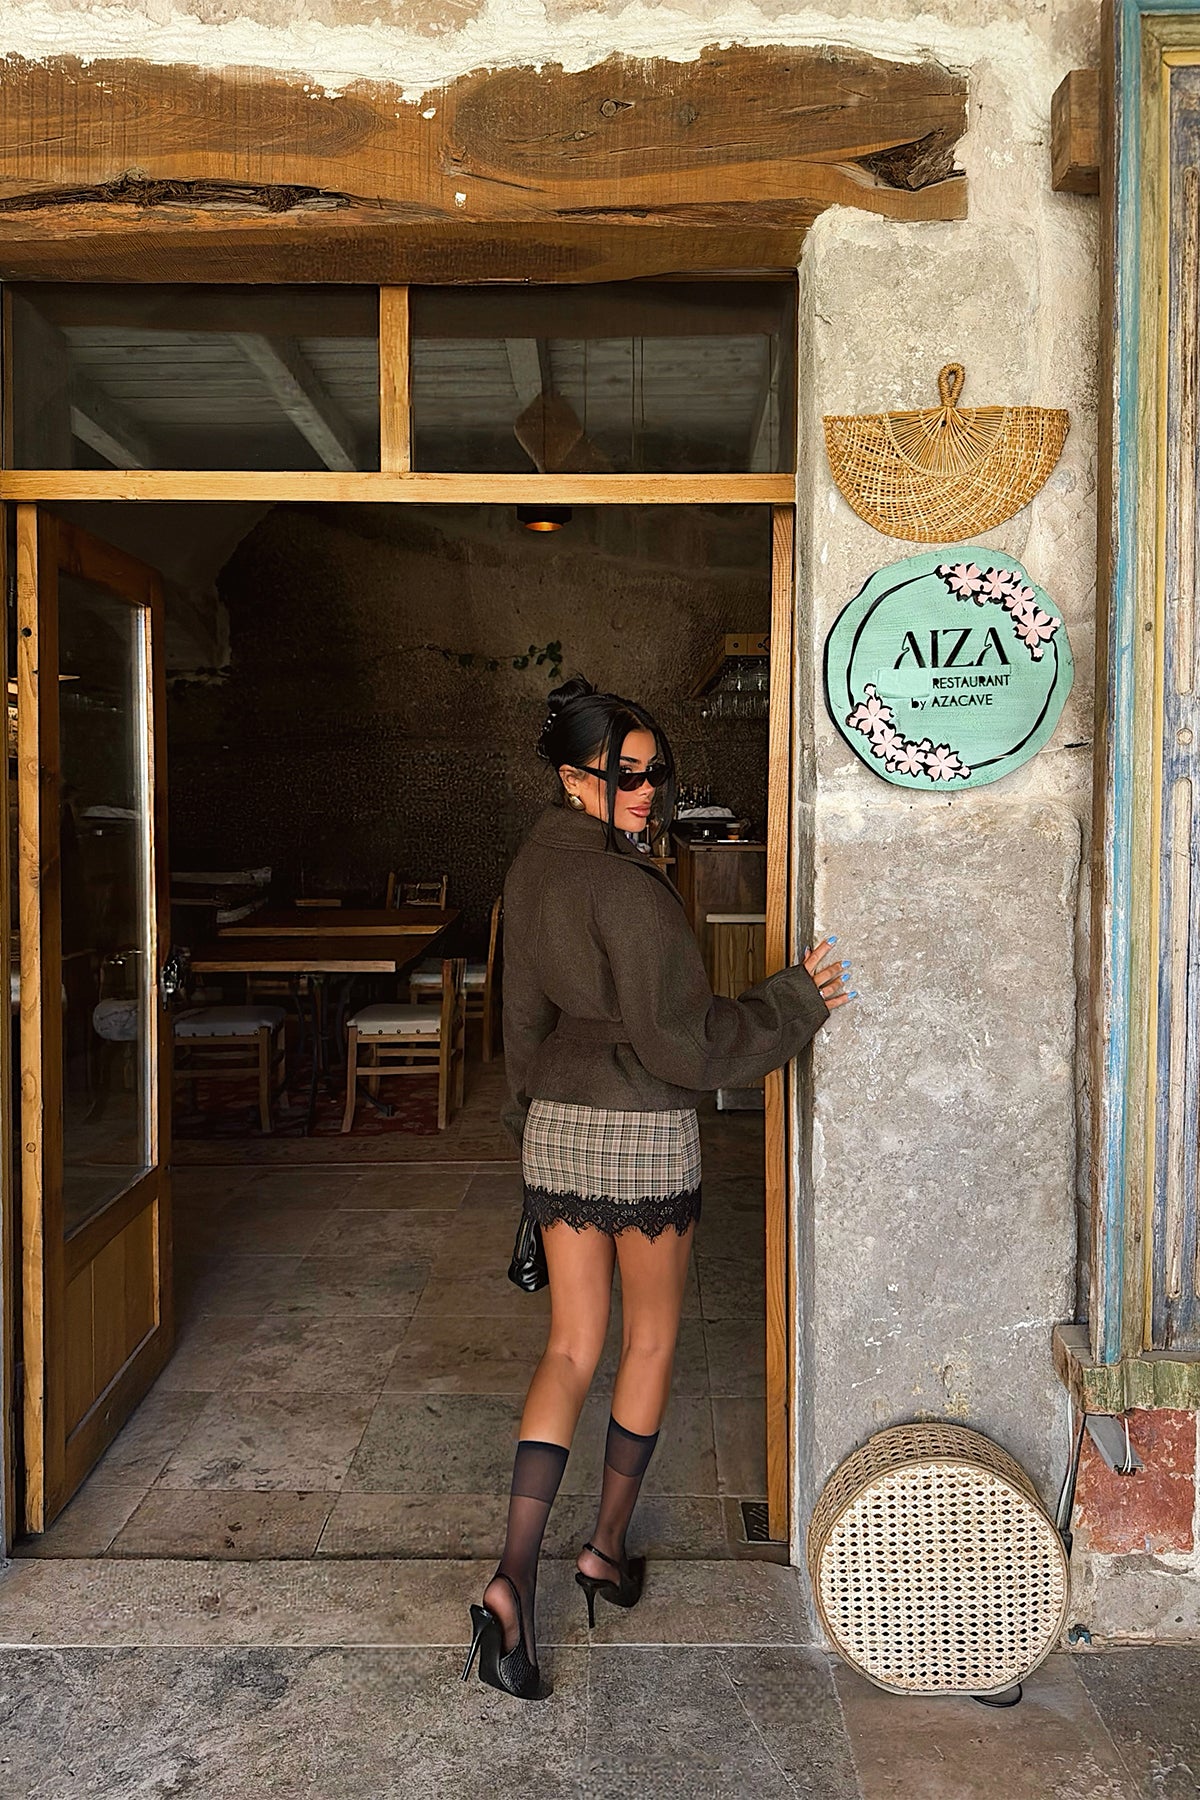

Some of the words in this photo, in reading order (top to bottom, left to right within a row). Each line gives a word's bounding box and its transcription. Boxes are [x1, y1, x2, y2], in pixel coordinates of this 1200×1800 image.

[893, 627, 1011, 670] AIZA
[932, 675, 1010, 689] RESTAURANT
[911, 697, 927, 710] by
[931, 694, 993, 707] AZACAVE
